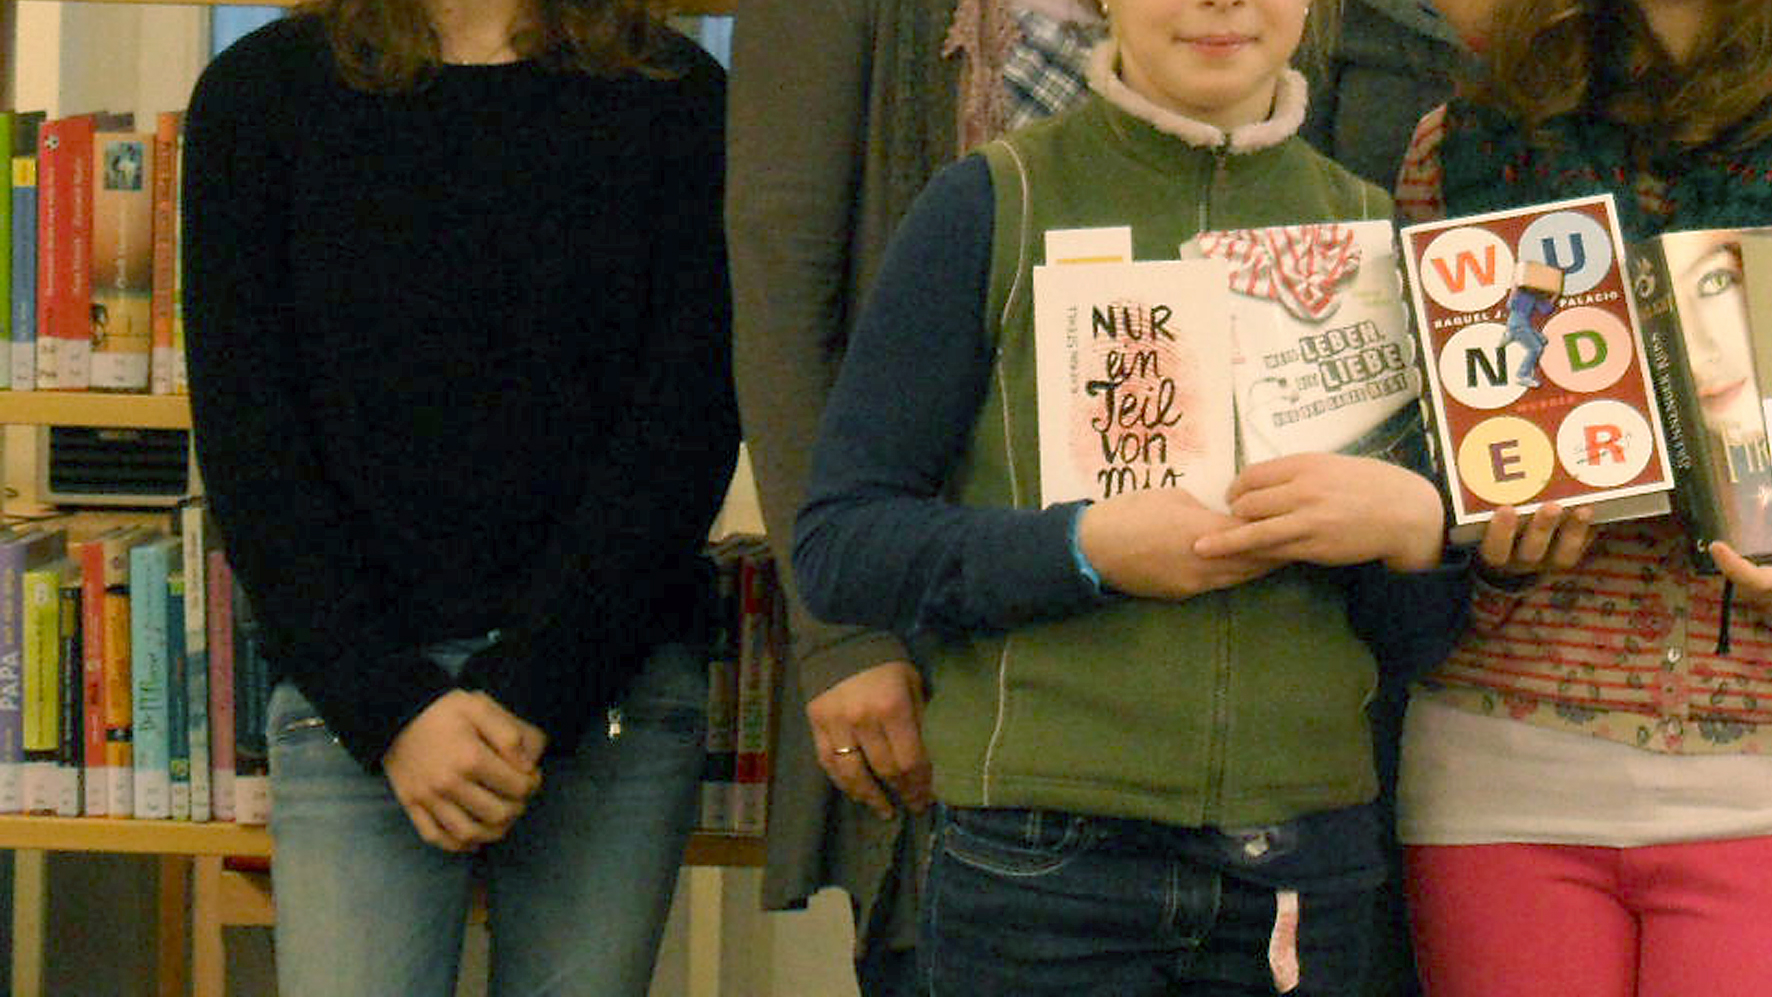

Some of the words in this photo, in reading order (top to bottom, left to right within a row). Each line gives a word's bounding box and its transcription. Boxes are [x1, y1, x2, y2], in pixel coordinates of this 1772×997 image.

[1559, 290, 1620, 308] PALACIO
[1092, 304, 1176, 341] NUR
[1106, 350, 1161, 384] ein
[1319, 344, 1405, 392] LIEBE
[1085, 378, 1182, 432] Teil
[1101, 432, 1168, 465] von
